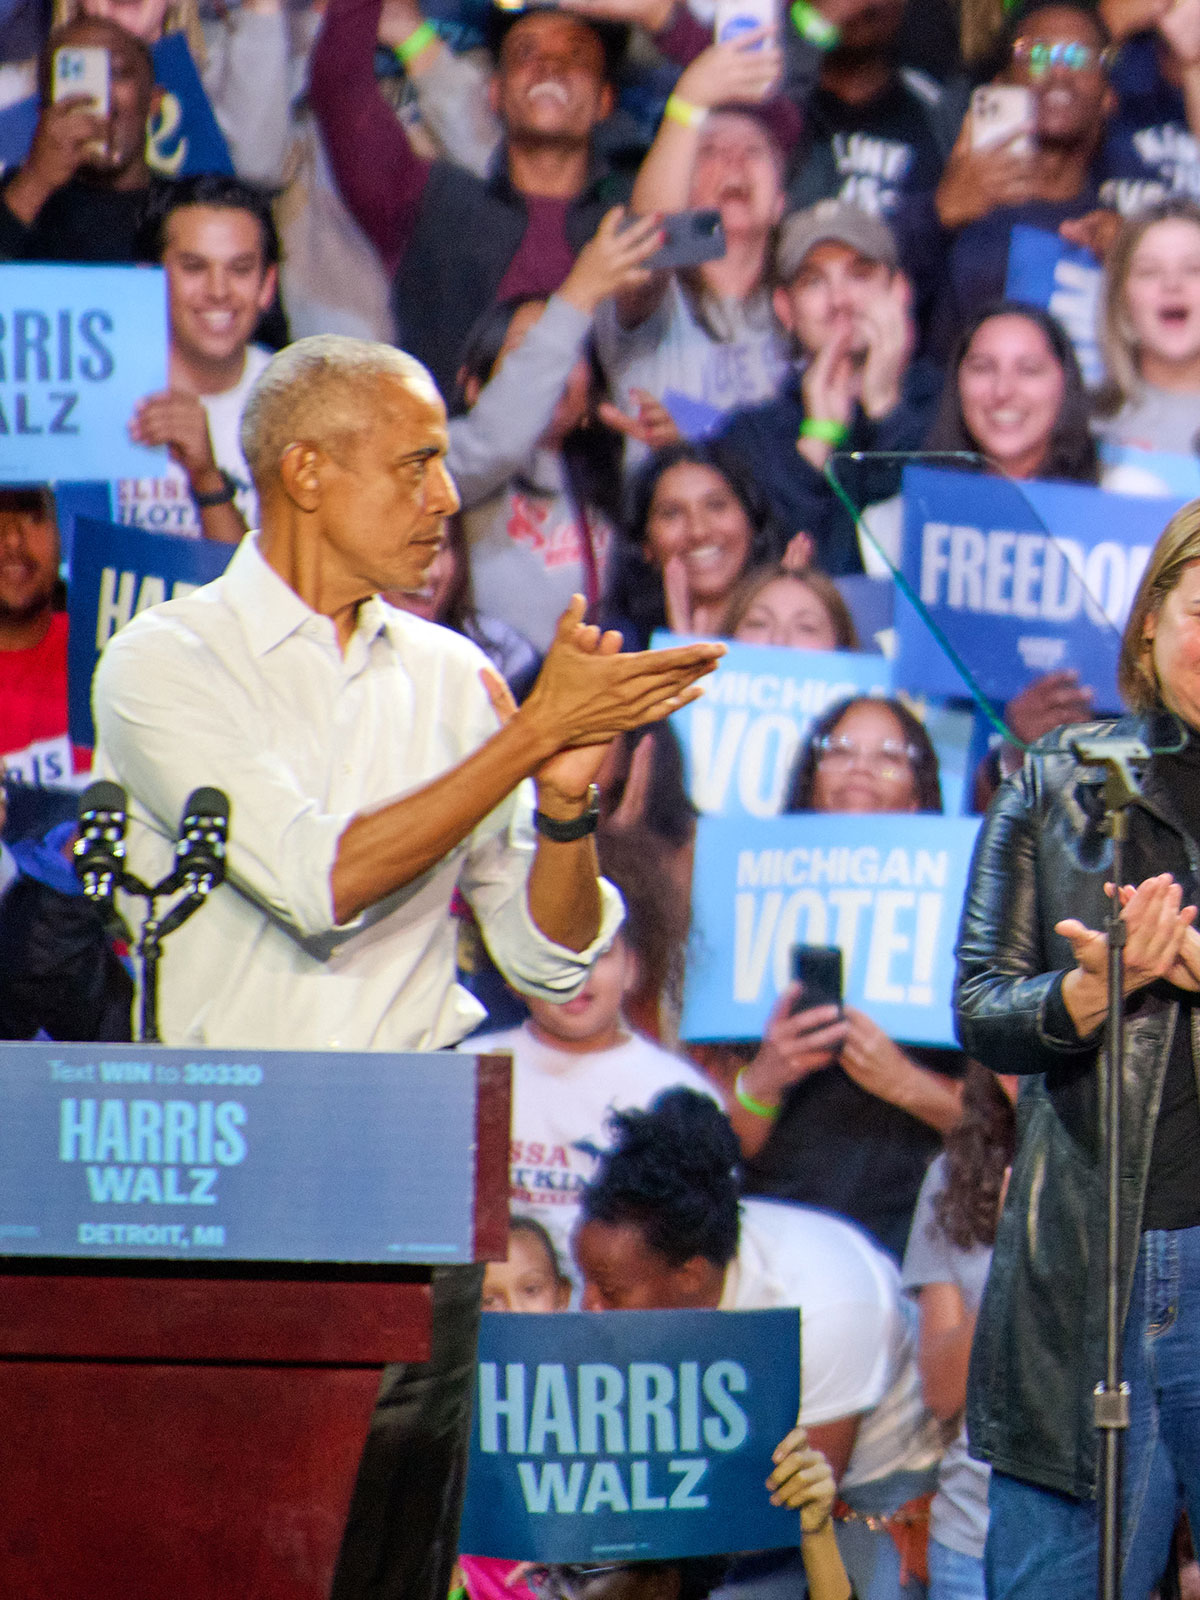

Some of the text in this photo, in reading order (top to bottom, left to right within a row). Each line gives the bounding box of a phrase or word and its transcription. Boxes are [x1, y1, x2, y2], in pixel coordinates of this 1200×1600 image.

[736, 847, 948, 887] MICHIGAN
[732, 888, 943, 1004] VOTE!
[48, 1060, 96, 1083] Text
[99, 1061, 151, 1084] WIN
[156, 1065, 181, 1084] to
[59, 1098, 249, 1166] HARRIS
[86, 1166, 219, 1206] WALZ
[77, 1222, 226, 1248] DETROIT, MI
[479, 1360, 749, 1454] HARRIS
[517, 1458, 709, 1514] WALZ
